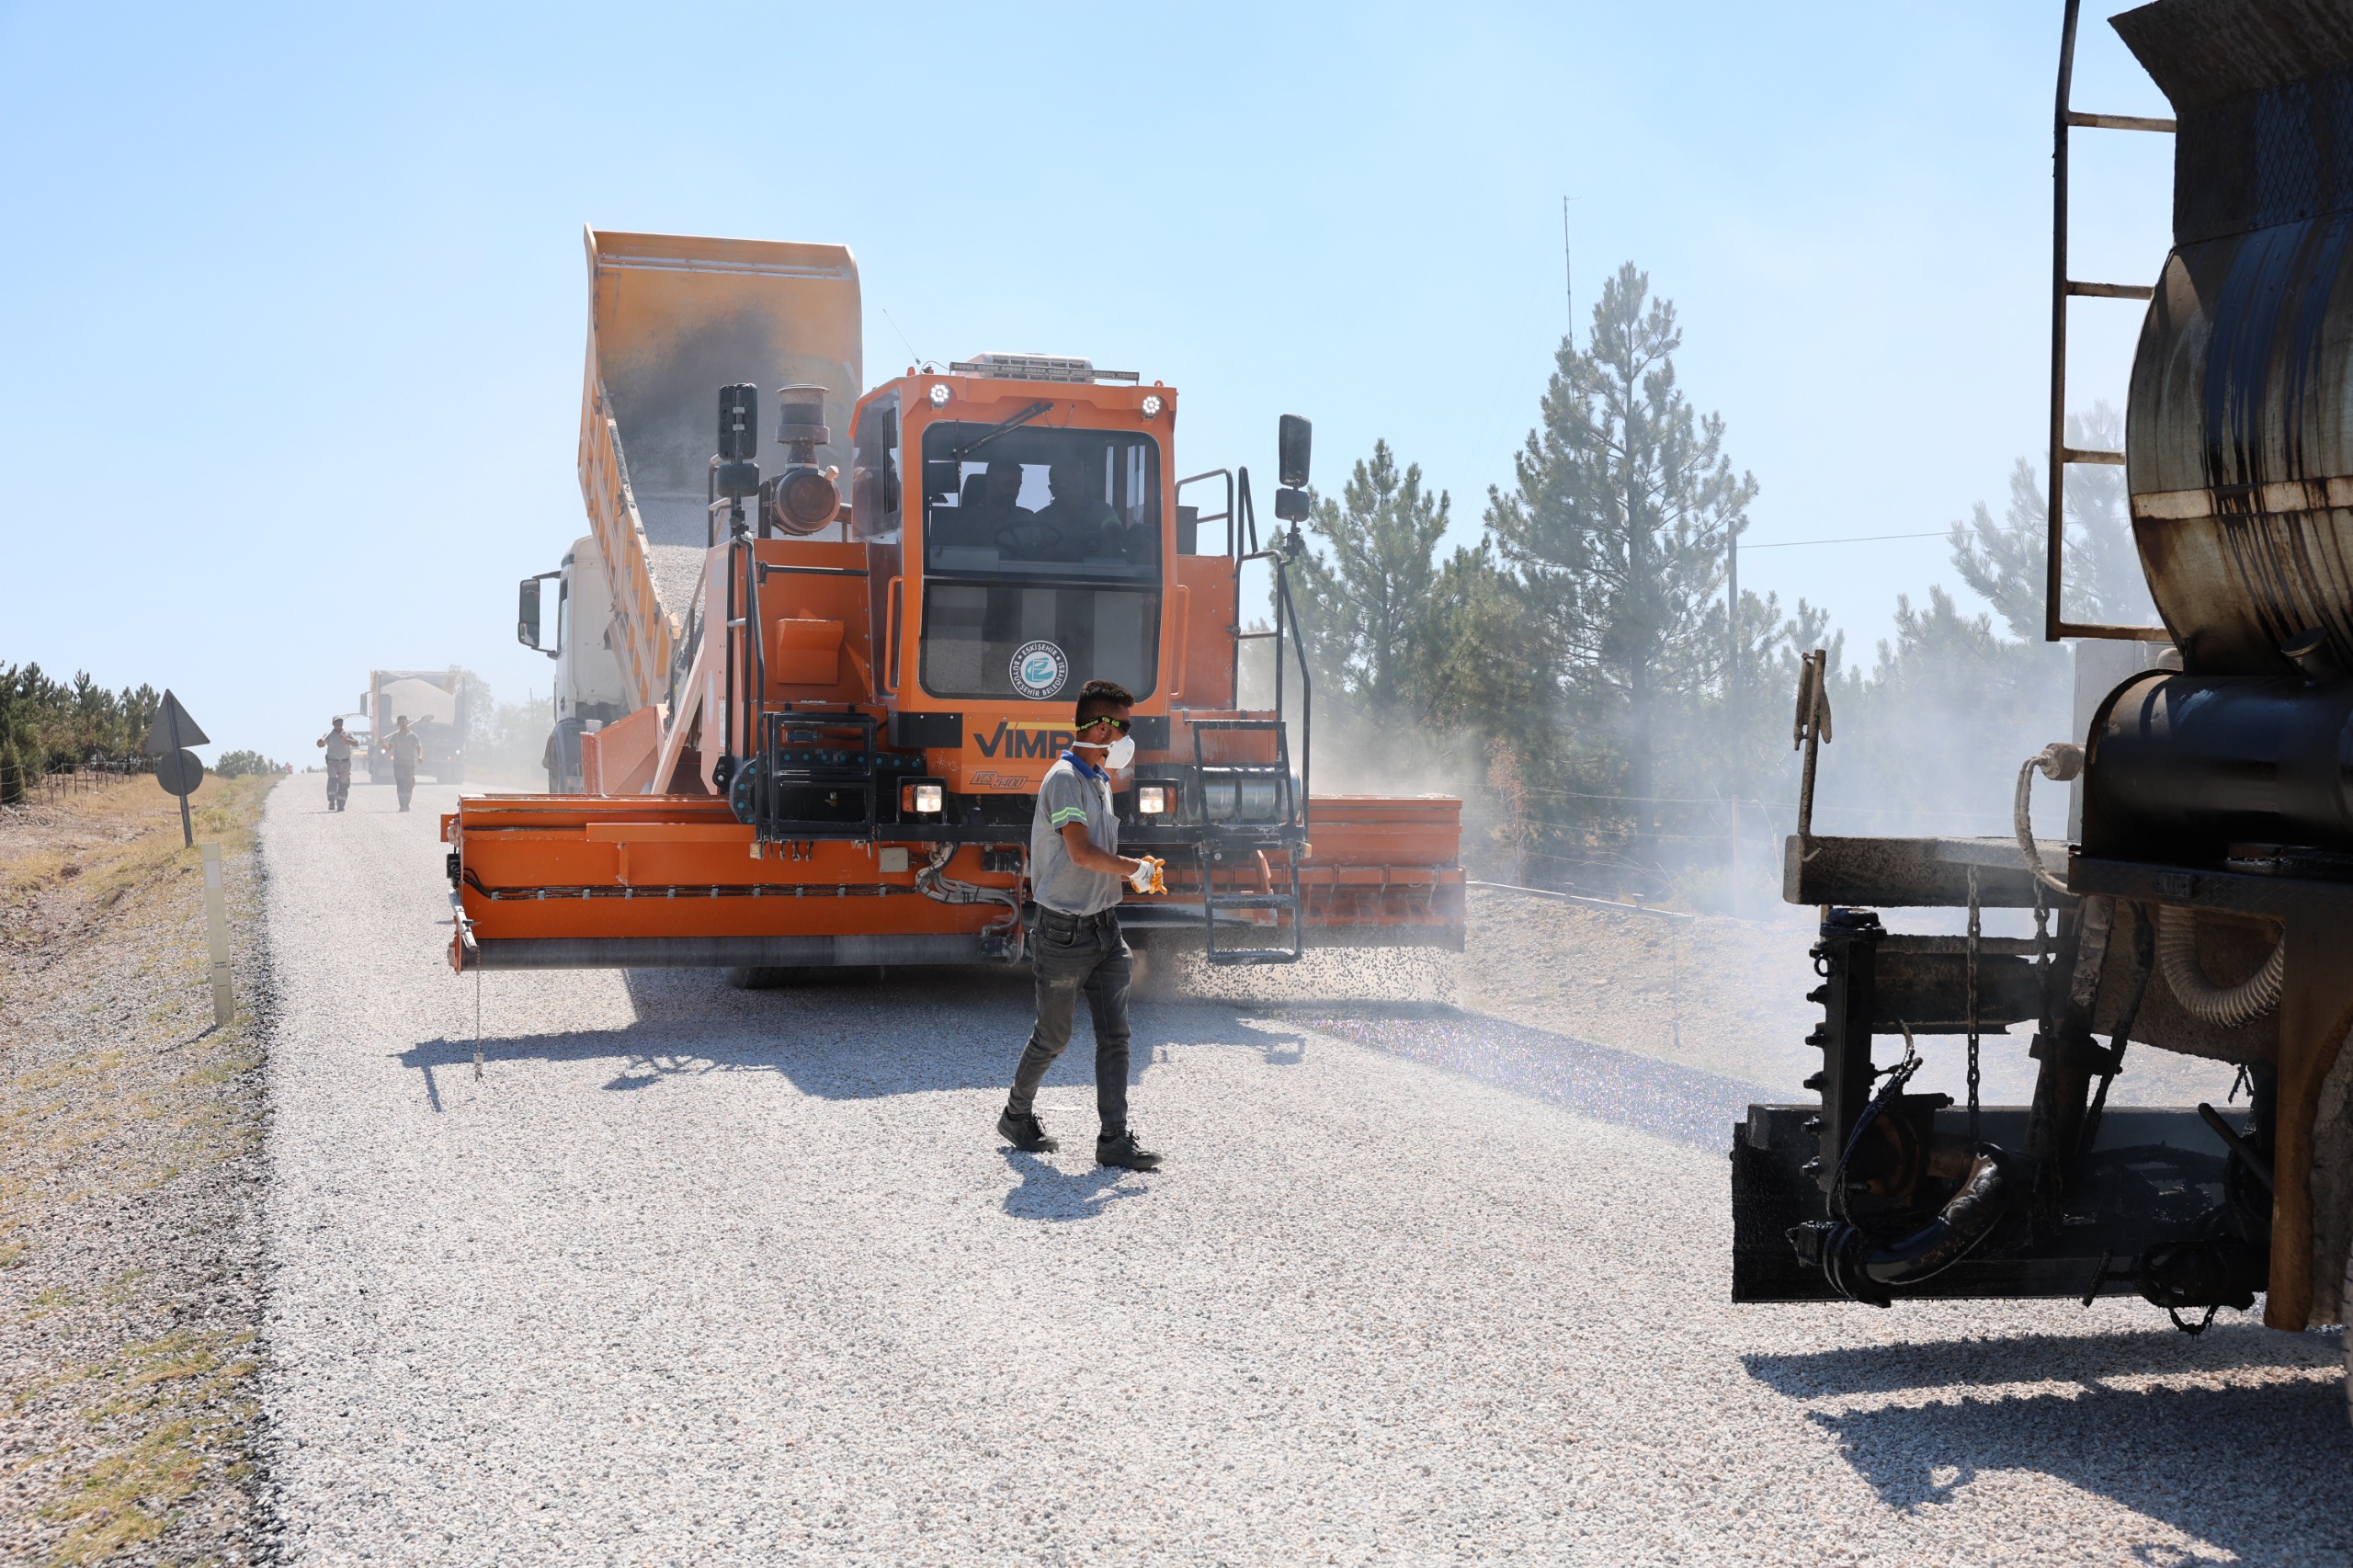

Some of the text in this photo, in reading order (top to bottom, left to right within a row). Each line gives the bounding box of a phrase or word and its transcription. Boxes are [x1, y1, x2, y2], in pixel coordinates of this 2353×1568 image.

[1021, 643, 1058, 656] ESKİŞEHİR
[1013, 660, 1065, 697] BÜYÜKŞEHİR BELEDİYESİ
[972, 722, 1075, 759] VIMP
[976, 773, 1023, 788] VCS 5400
